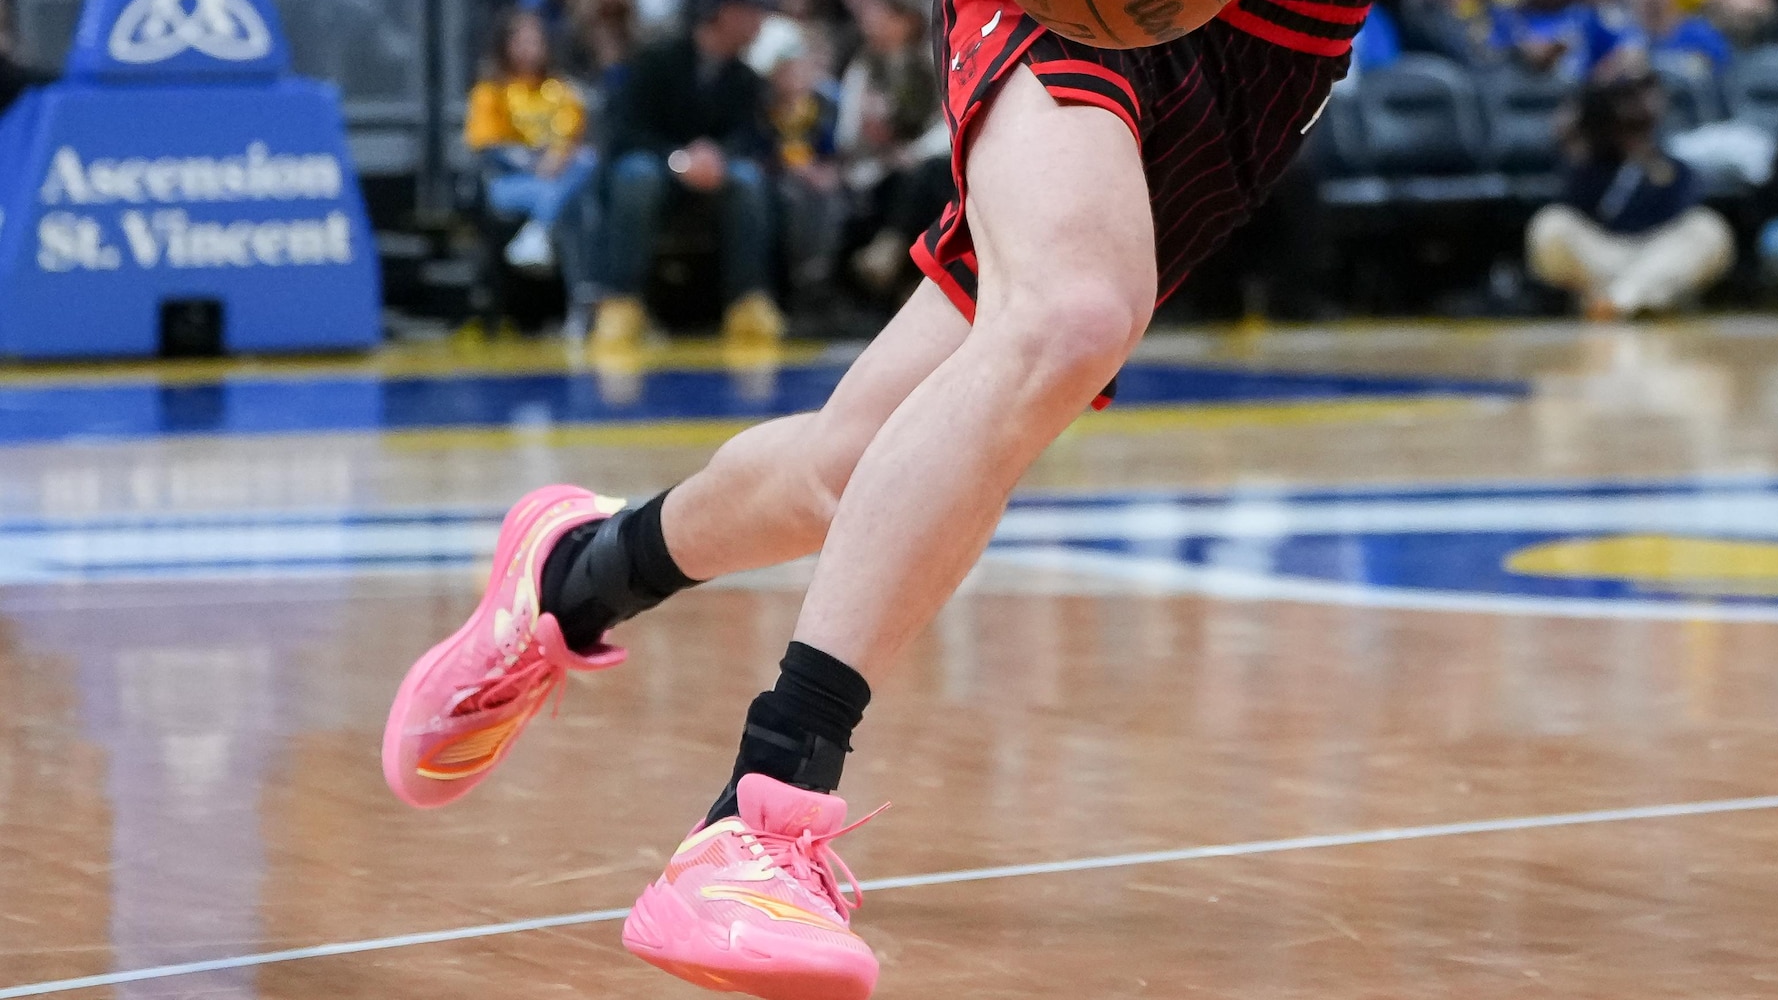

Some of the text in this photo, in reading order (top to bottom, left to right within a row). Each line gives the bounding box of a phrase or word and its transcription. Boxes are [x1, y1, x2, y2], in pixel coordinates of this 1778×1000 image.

[42, 142, 341, 203] Ascension
[38, 209, 351, 271] St. Vincent
